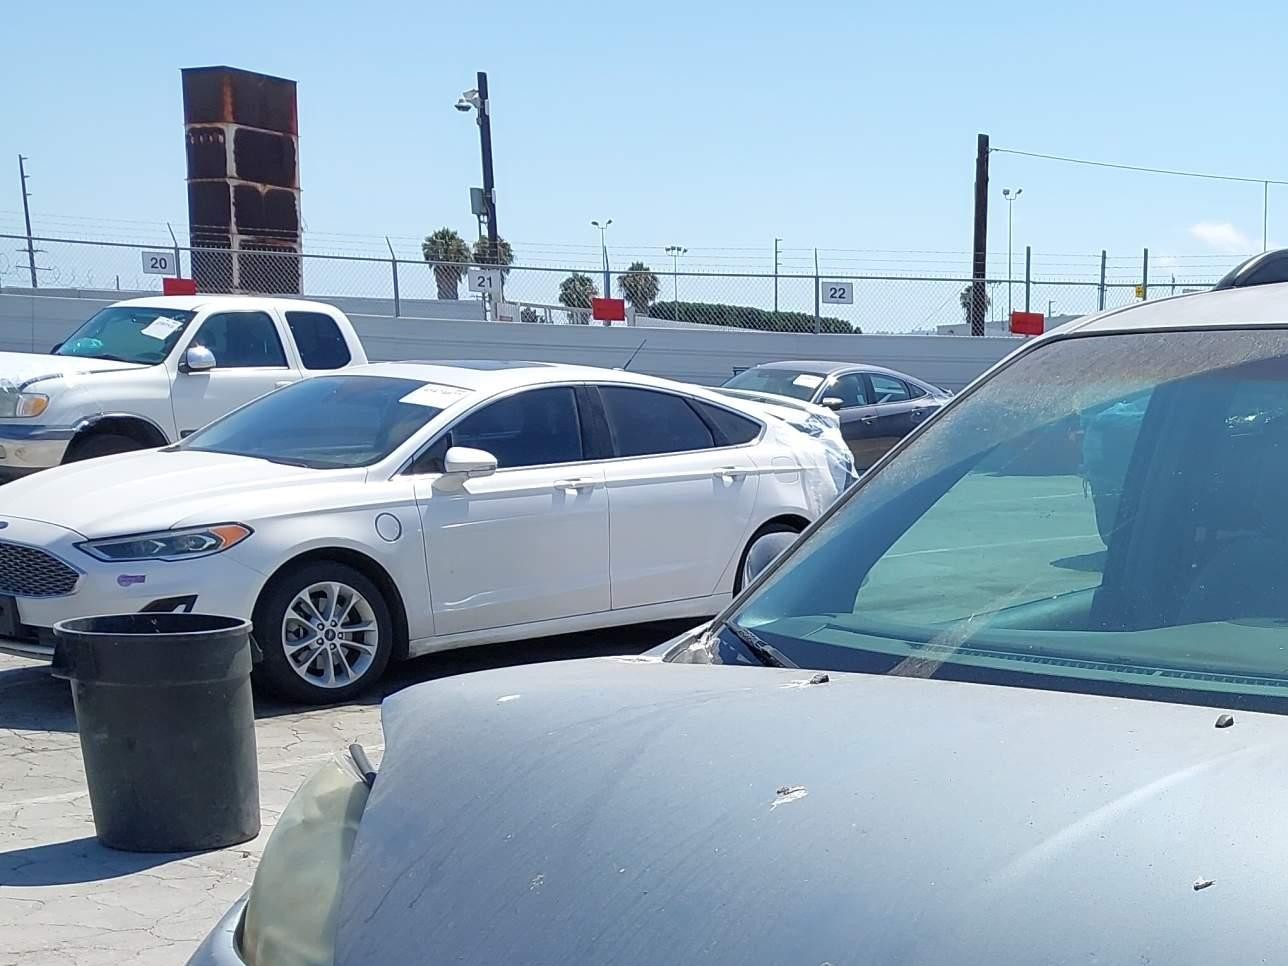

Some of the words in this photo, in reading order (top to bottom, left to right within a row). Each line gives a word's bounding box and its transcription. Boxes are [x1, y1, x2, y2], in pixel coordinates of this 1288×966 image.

[150, 256, 168, 270] 20
[477, 275, 493, 289] 21
[829, 287, 846, 299] 22
